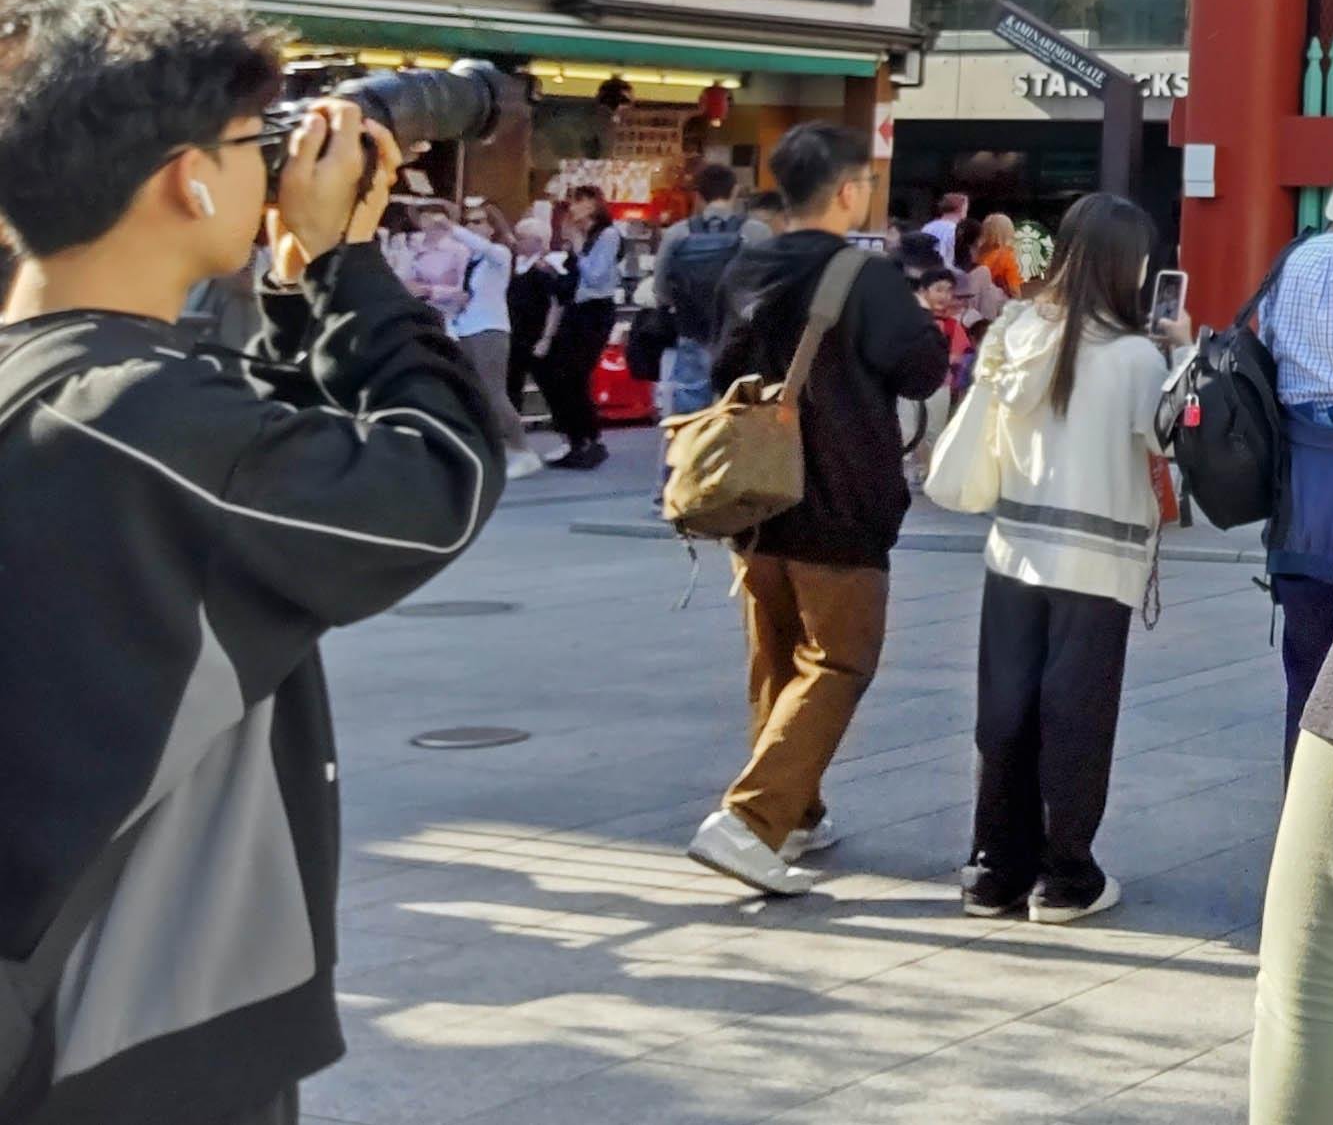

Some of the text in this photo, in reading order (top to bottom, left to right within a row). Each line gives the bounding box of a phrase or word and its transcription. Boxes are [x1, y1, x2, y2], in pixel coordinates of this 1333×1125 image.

[1003, 13, 1079, 69] KAMINARIMON
[1077, 58, 1107, 84] GATE
[1012, 72, 1190, 97] STARCKS
